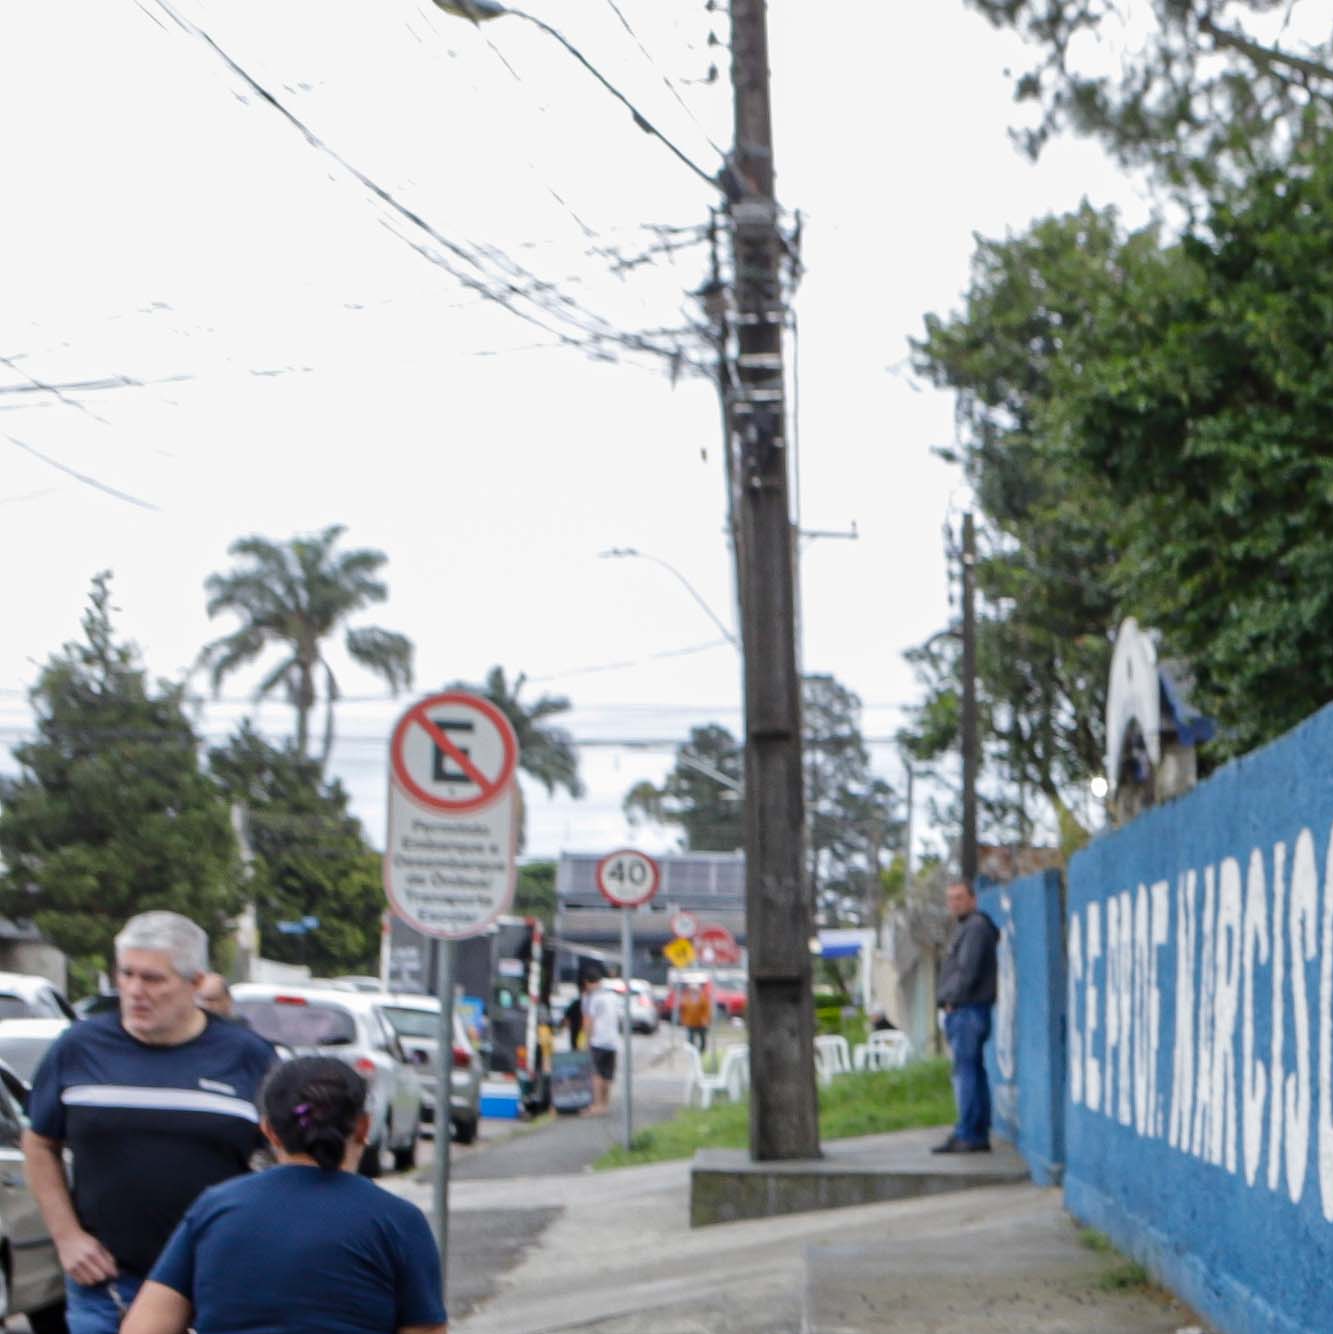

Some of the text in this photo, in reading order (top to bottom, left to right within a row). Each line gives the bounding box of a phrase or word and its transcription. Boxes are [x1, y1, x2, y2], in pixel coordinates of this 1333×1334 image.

[401, 837, 484, 854] Embarque
[394, 856, 506, 873] Desembarque
[608, 860, 647, 886] 40
